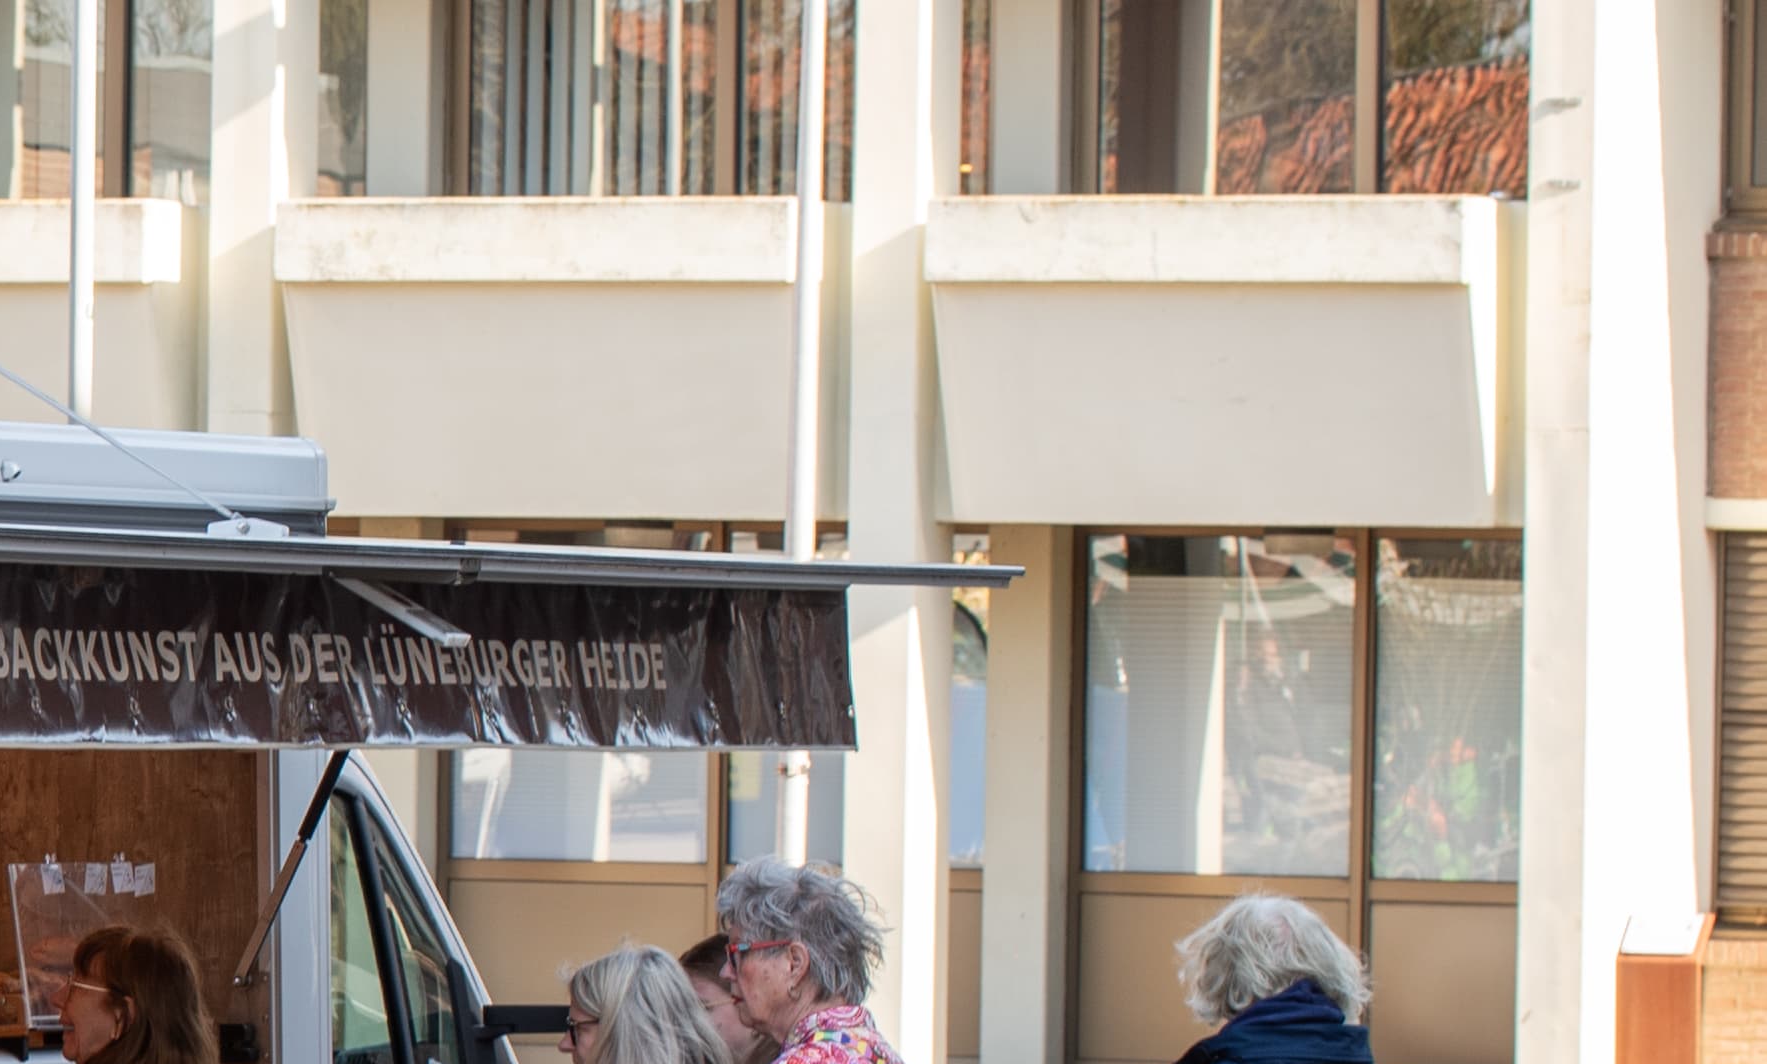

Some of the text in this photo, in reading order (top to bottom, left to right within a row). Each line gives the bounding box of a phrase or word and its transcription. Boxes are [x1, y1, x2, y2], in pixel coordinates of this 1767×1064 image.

[214, 631, 282, 683] AUS
[289, 633, 360, 684] DER
[363, 624, 572, 688] LÜNEBURGER
[577, 641, 667, 690] HEIDE
